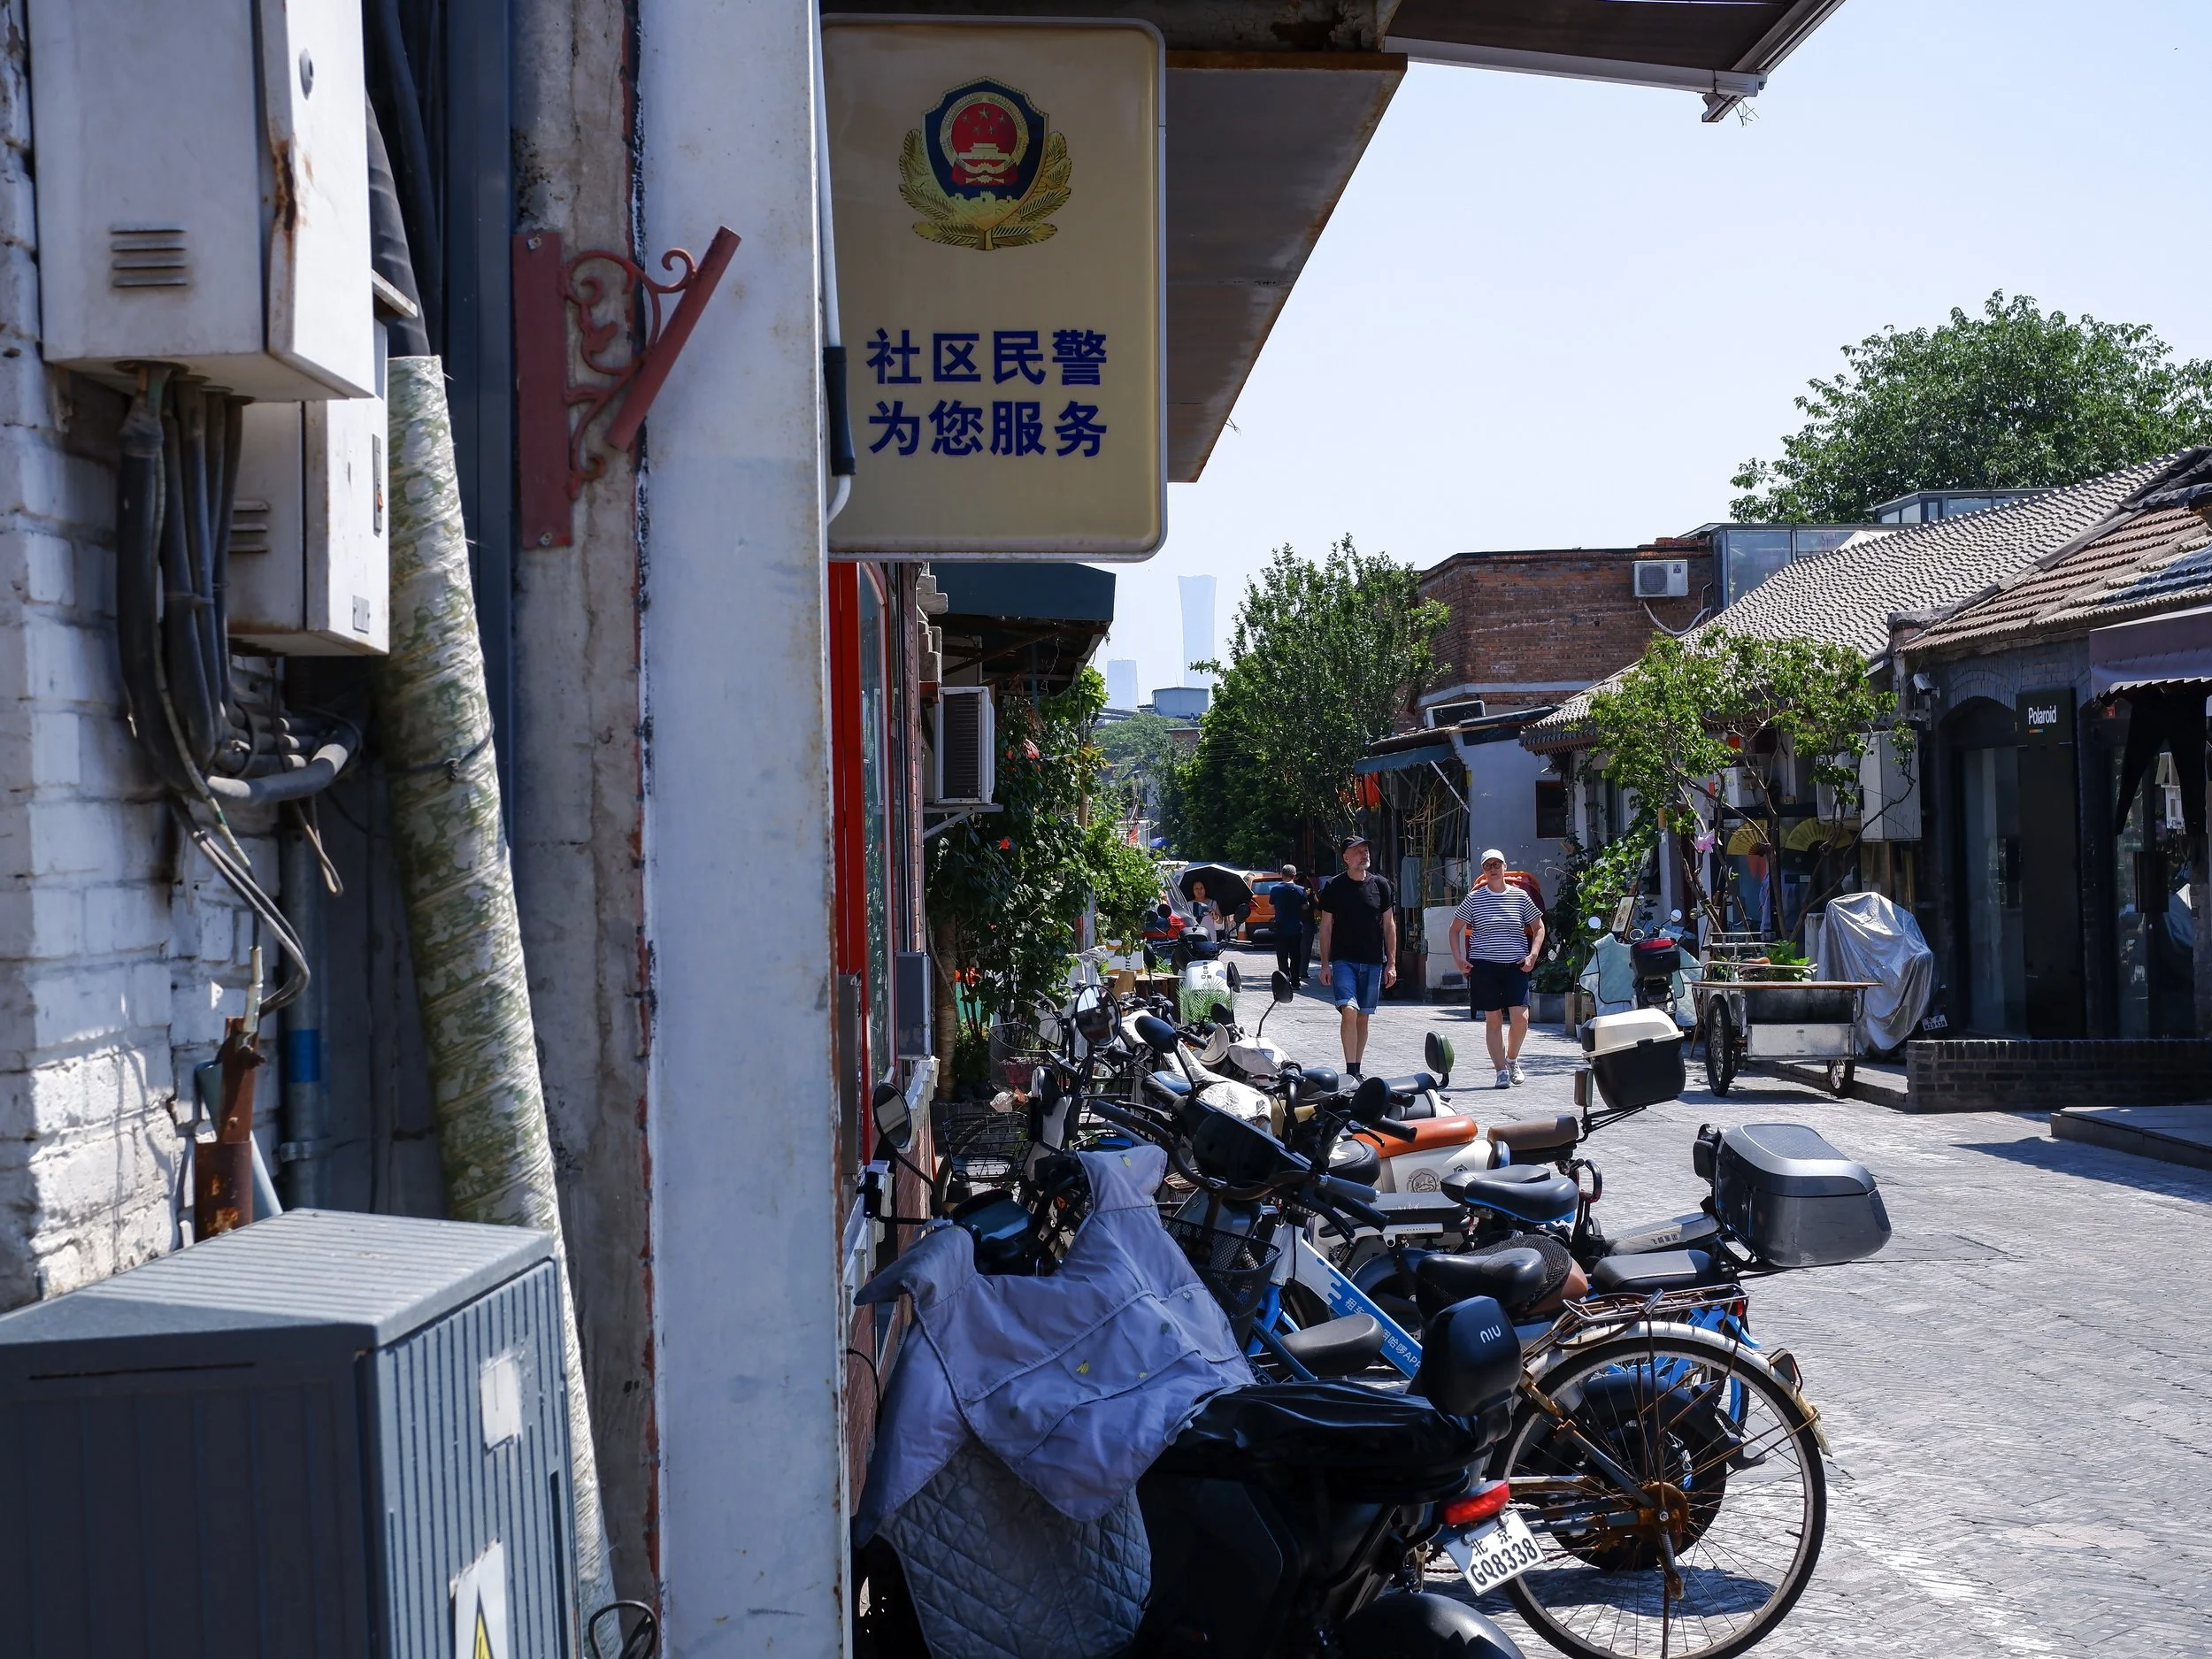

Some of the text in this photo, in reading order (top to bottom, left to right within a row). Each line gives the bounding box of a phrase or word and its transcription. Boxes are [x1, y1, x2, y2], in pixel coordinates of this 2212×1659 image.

[866, 328, 1107, 386] 社区民警
[868, 400, 1108, 457] 为您服务
[2028, 705, 2057, 725] Polaroid
[1470, 1538, 1538, 1586] GQ8338
